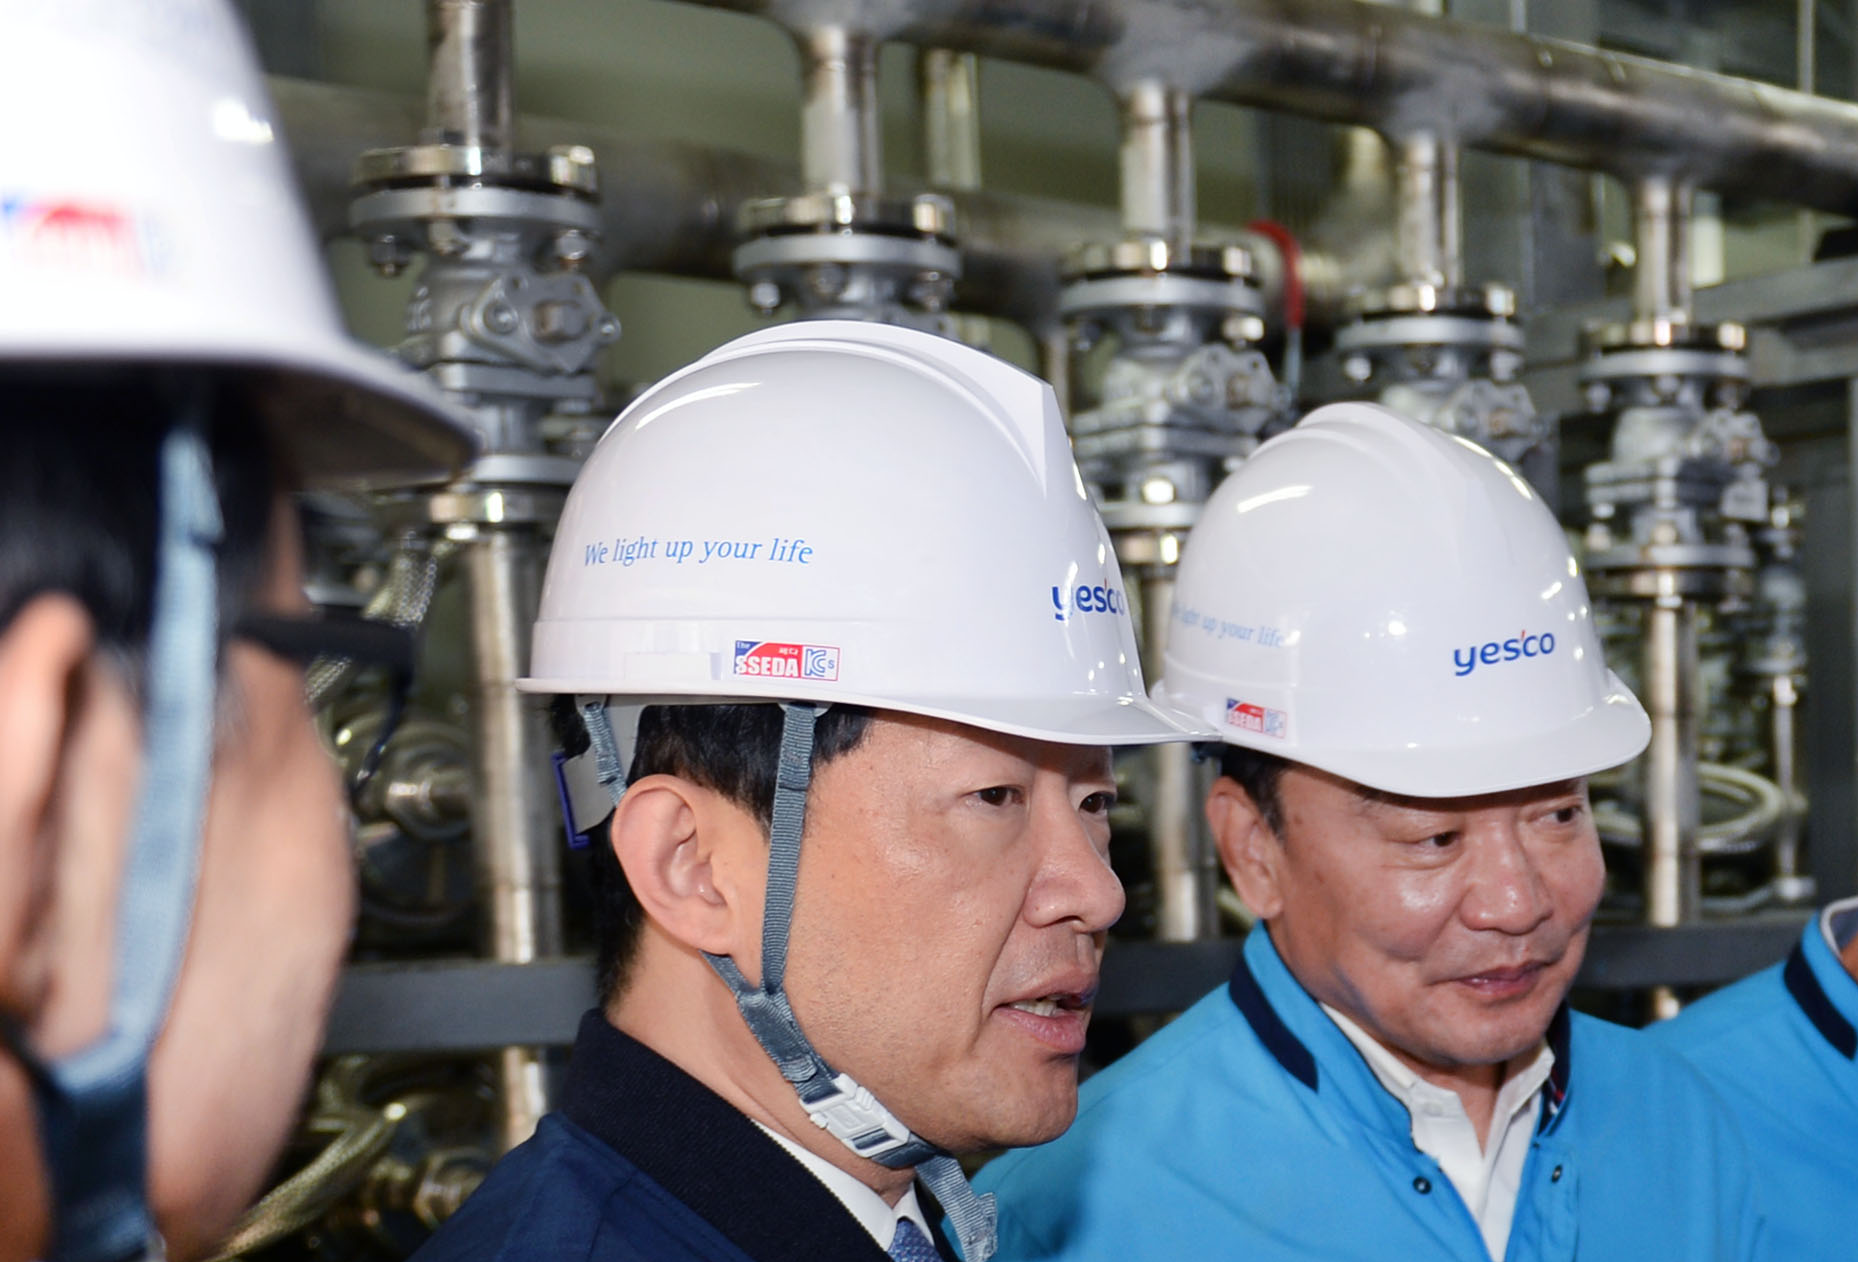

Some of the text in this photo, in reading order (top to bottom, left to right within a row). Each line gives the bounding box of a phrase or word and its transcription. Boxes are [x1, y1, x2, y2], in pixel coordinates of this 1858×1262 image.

[585, 536, 813, 567] We light up your life
[1454, 629, 1554, 676] yesco
